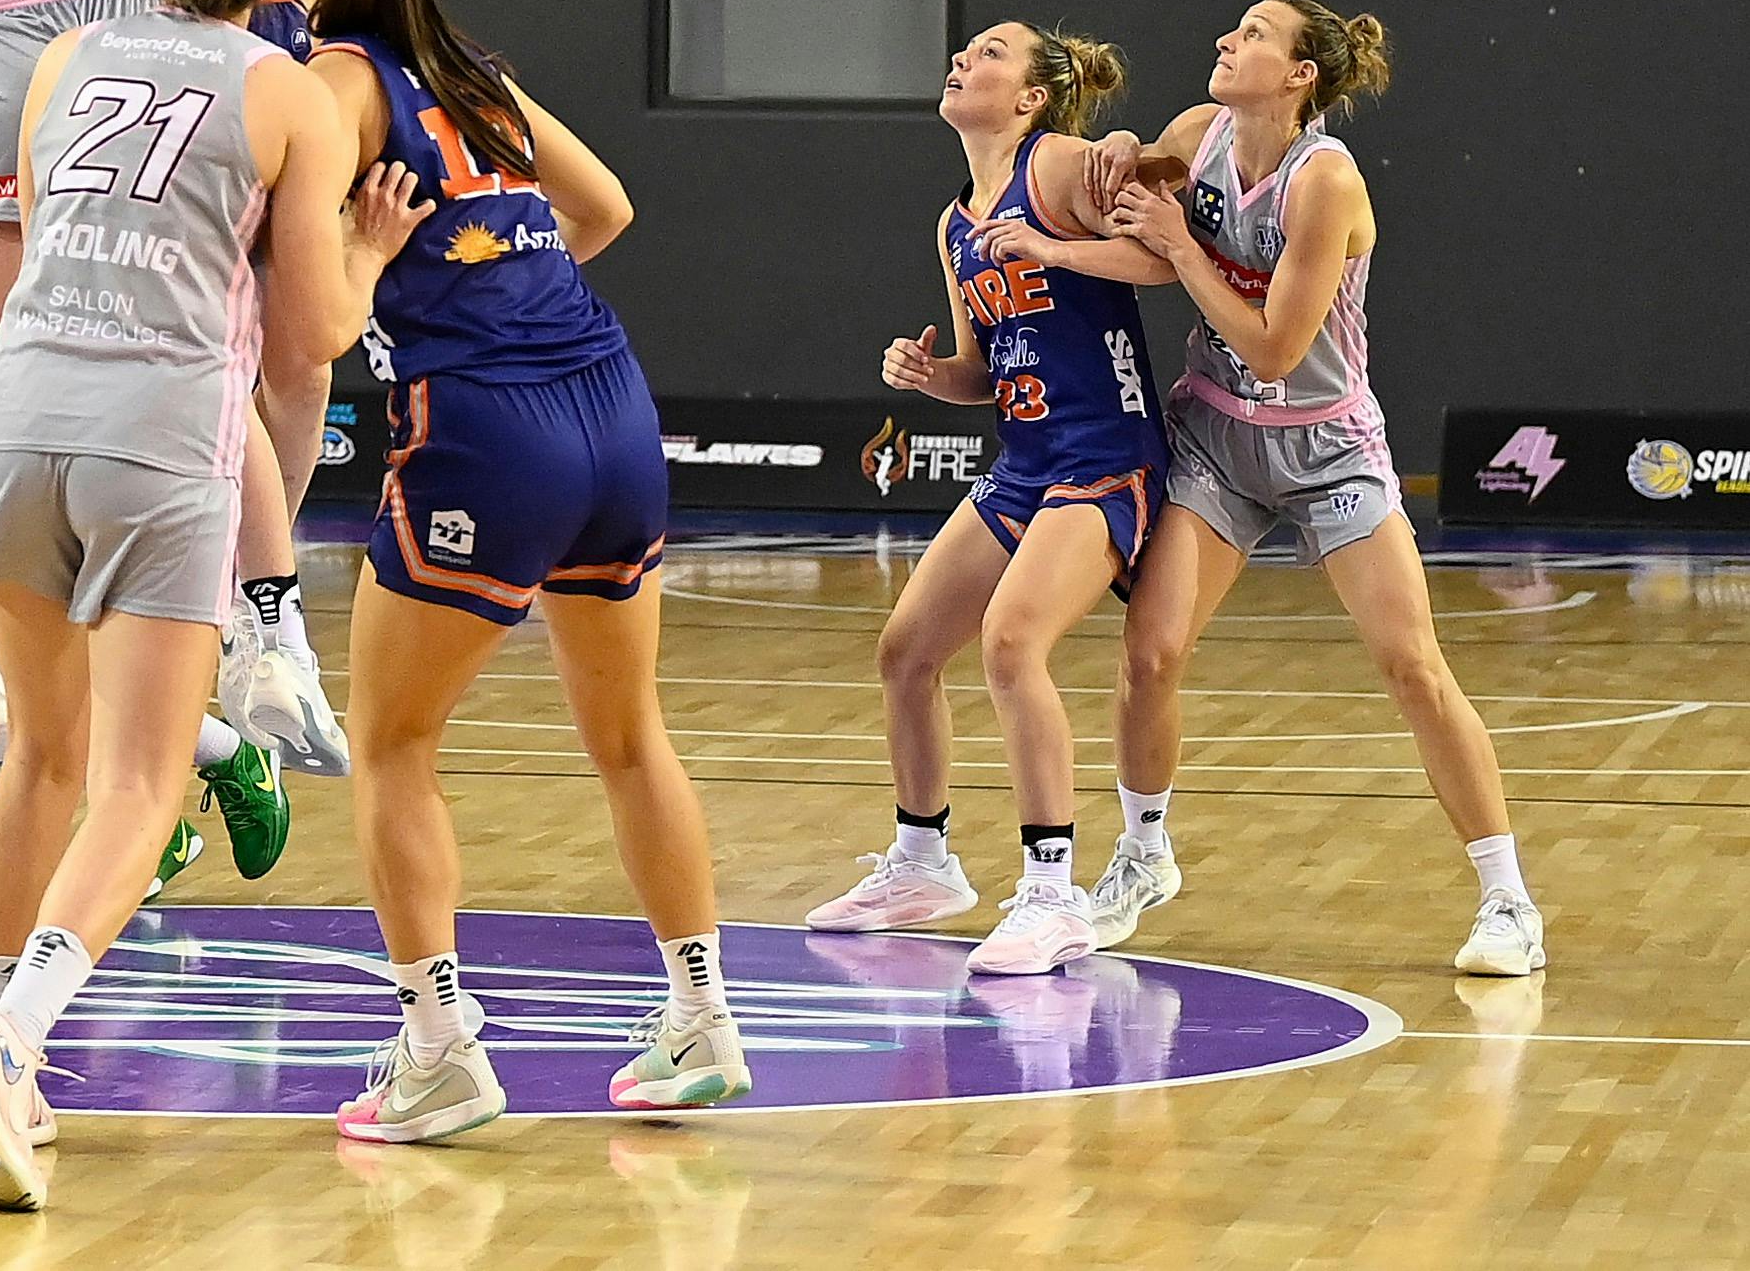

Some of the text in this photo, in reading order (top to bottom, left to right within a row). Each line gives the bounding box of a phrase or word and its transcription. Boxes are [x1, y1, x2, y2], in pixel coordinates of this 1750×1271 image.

[100, 31, 226, 65] Beyond Bank
[48, 77, 216, 204] 21
[50, 285, 134, 316] SALON
[959, 260, 1055, 327] IRE
[16, 311, 173, 346] WAREHOUSE
[908, 449, 983, 482] FIRE
